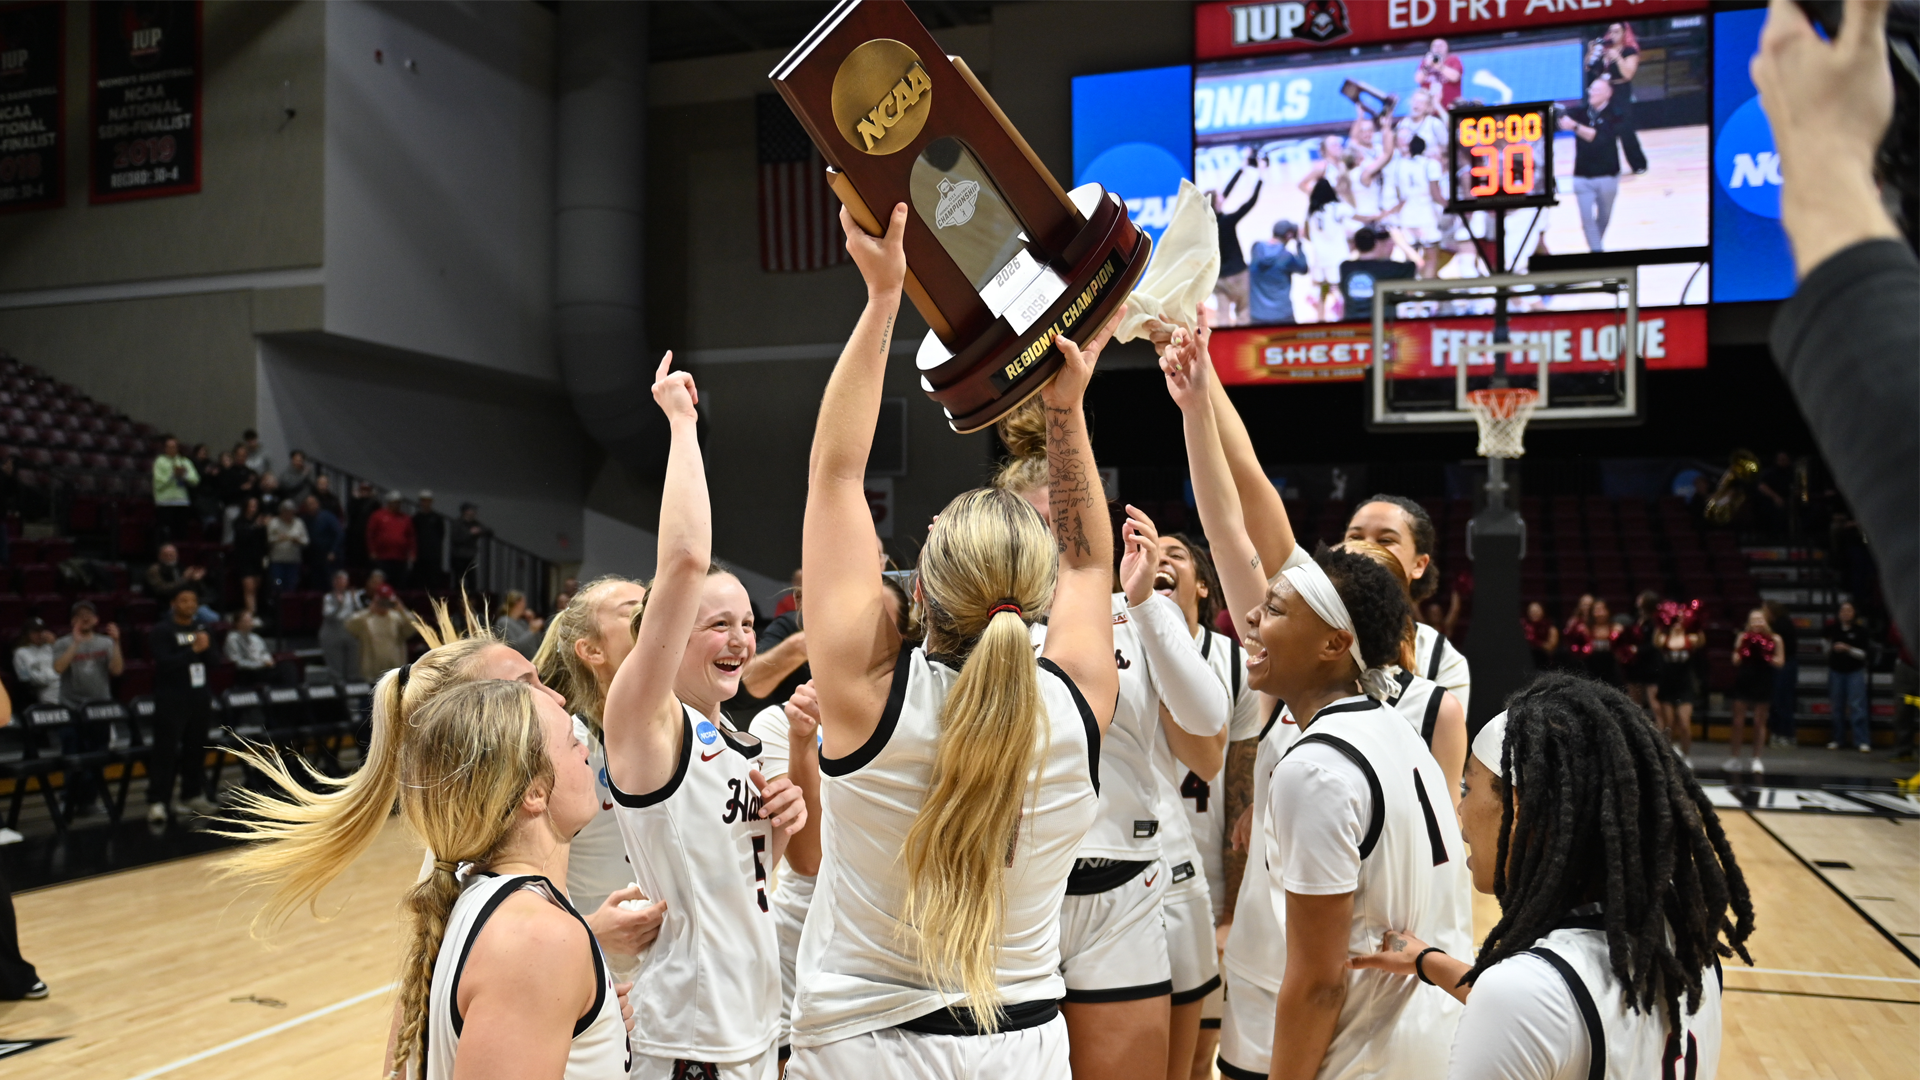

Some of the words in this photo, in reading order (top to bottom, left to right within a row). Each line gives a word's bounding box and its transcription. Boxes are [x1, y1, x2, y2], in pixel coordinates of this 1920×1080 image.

[1233, 3, 1305, 44] IUP
[1388, 0, 1437, 29] ED
[132, 28, 162, 49] IUP
[108, 98, 183, 121] NATIONAL
[125, 84, 166, 102] NCAA
[857, 61, 932, 151] NCAA
[98, 112, 193, 139] SEMI-FINALIST
[1460, 112, 1542, 148] 60:00
[114, 134, 177, 169] 2019
[1470, 143, 1535, 197] 30
[937, 183, 978, 227] CHAMPIONSHIP
[995, 257, 1021, 288] 2026
[1004, 322, 1064, 380] REGIONAL
[1062, 259, 1115, 327] CHAMPION
[1265, 342, 1390, 365] SHEET
[1510, 329, 1572, 364] THE
[1180, 770, 1210, 813] 4
[1413, 767, 1449, 867] 1
[751, 835, 769, 913] 5
